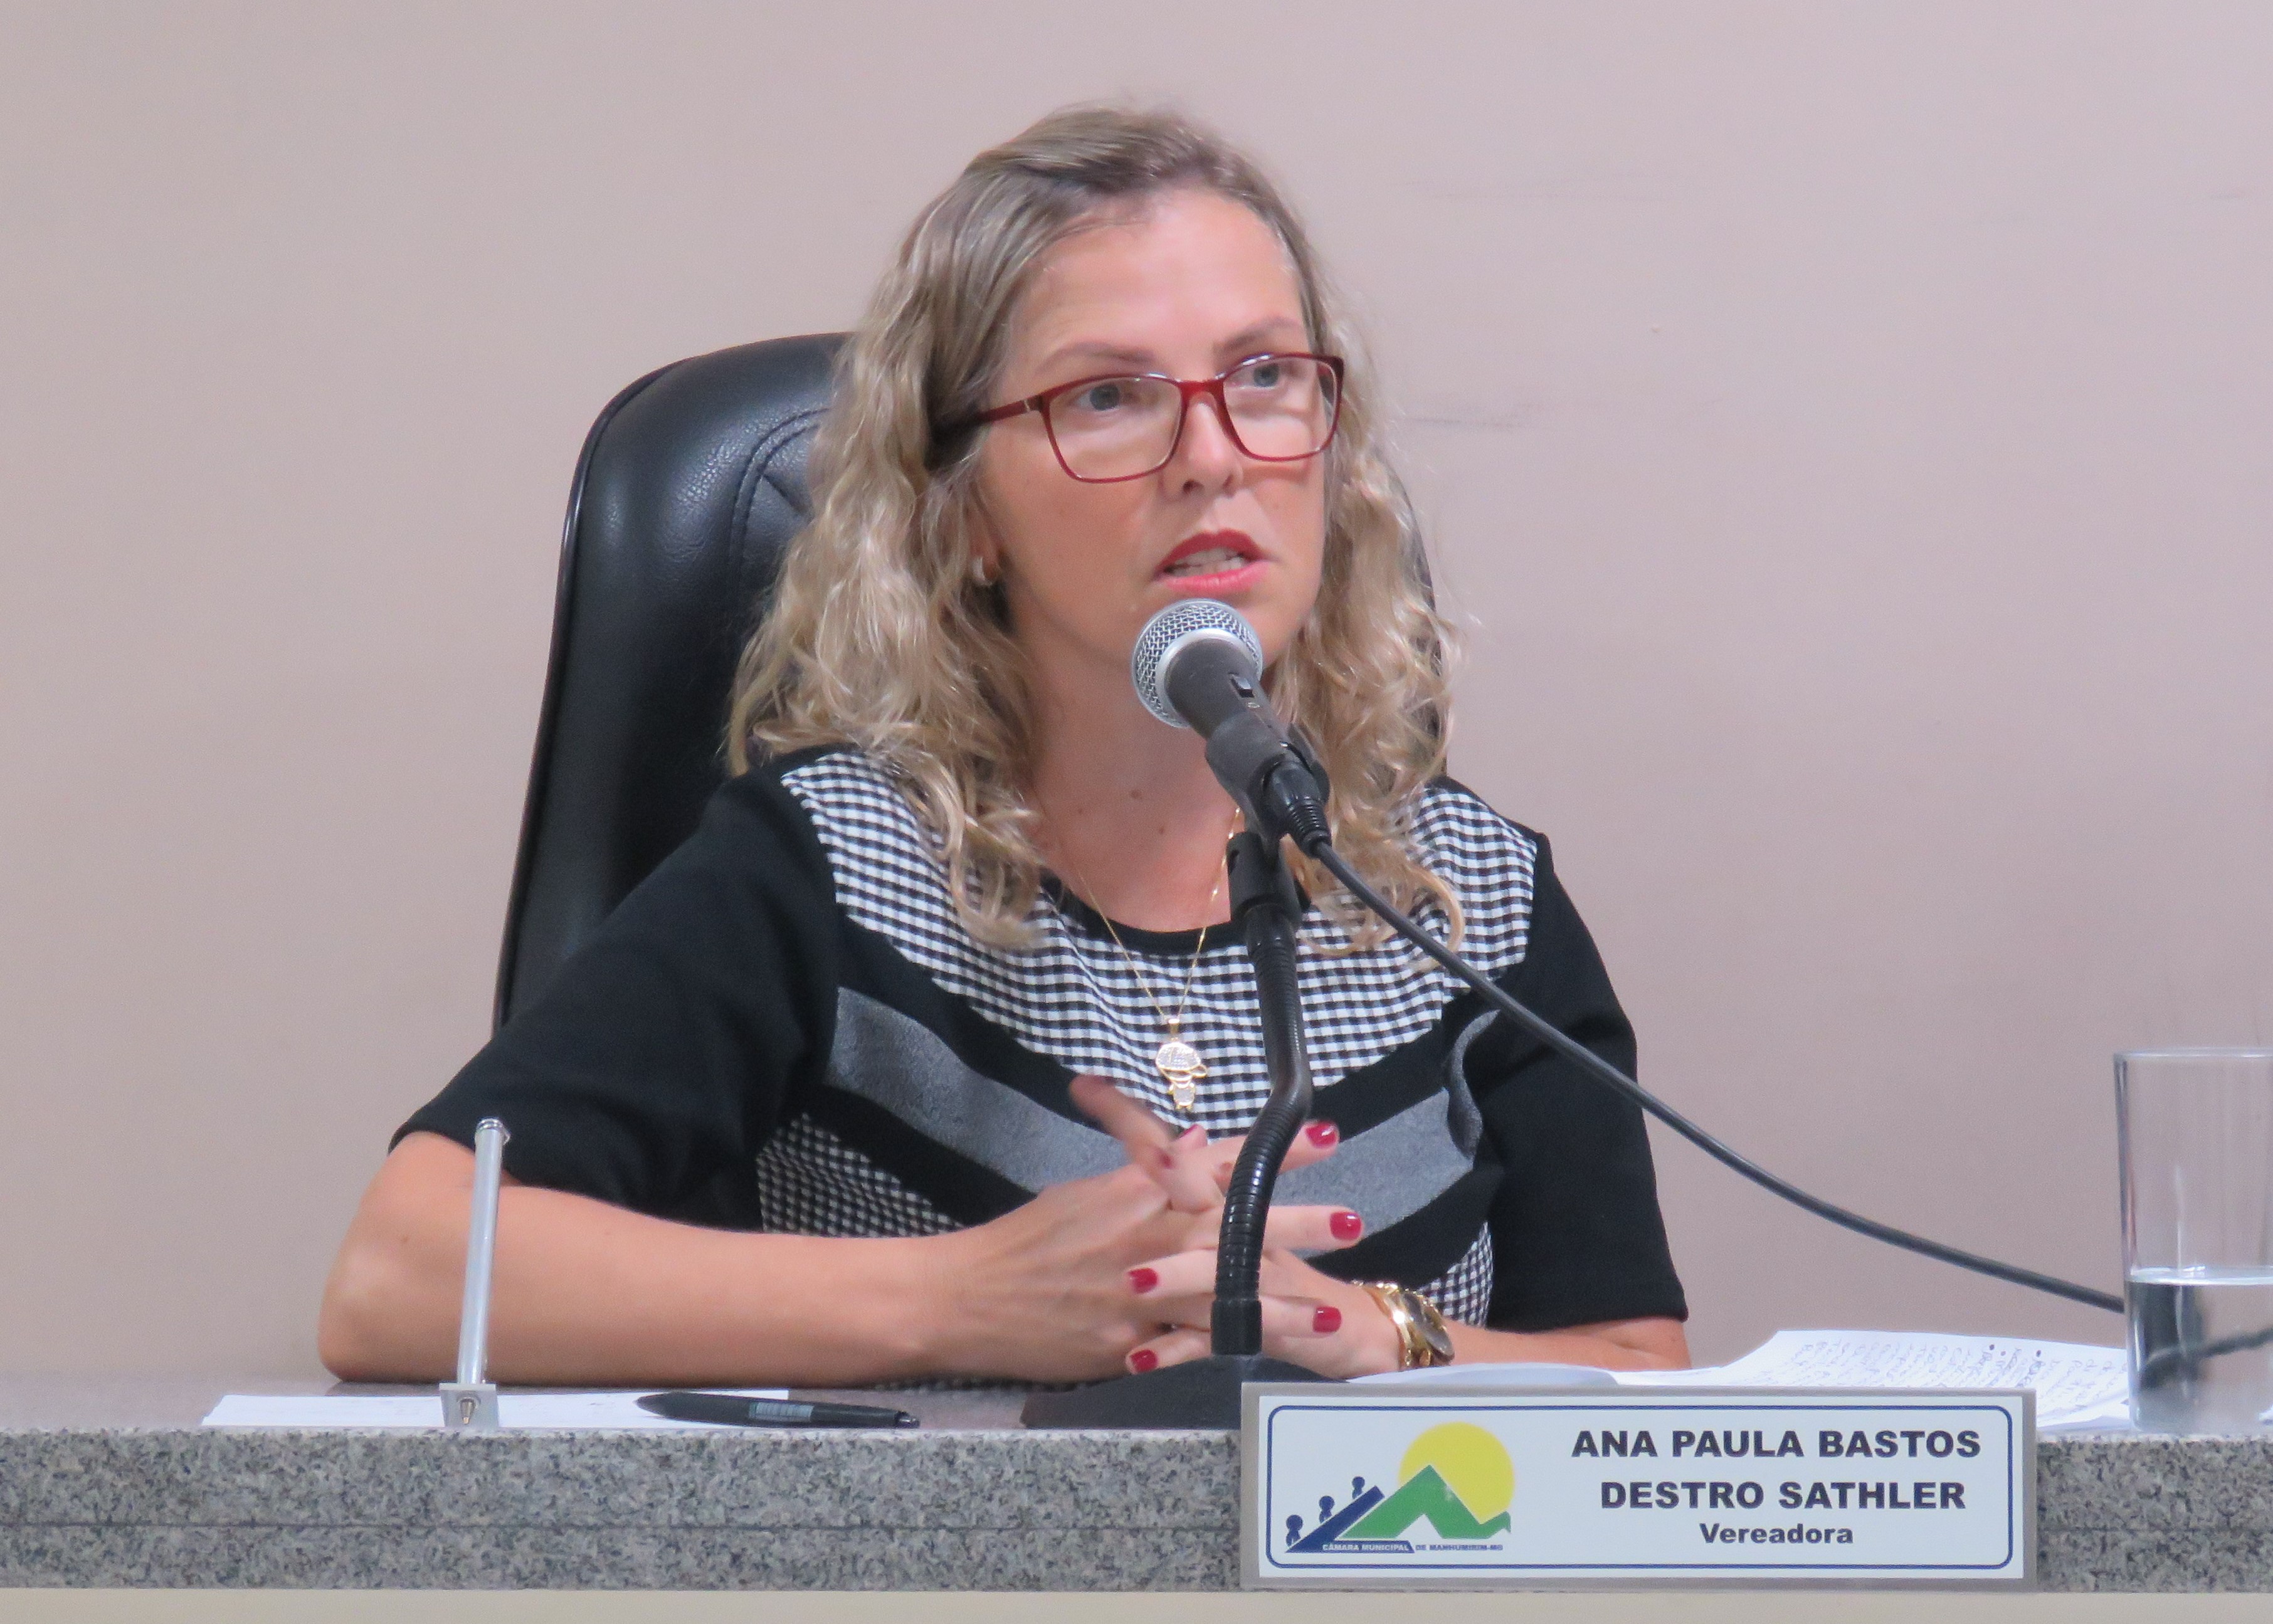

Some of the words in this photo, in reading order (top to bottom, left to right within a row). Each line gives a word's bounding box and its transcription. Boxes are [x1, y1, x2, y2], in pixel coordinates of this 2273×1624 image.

[1571, 1430, 1658, 1458] ANA
[1672, 1430, 1805, 1458] PAULA
[1818, 1430, 1981, 1458] BASTOS
[1601, 1481, 1764, 1509] DESTRO
[1778, 1481, 1966, 1509] SATHLER
[1699, 1522, 1854, 1544] Vereadora
[1322, 1542, 1359, 1551] CÂMARA
[1361, 1543, 1410, 1551] MUNICIPAL
